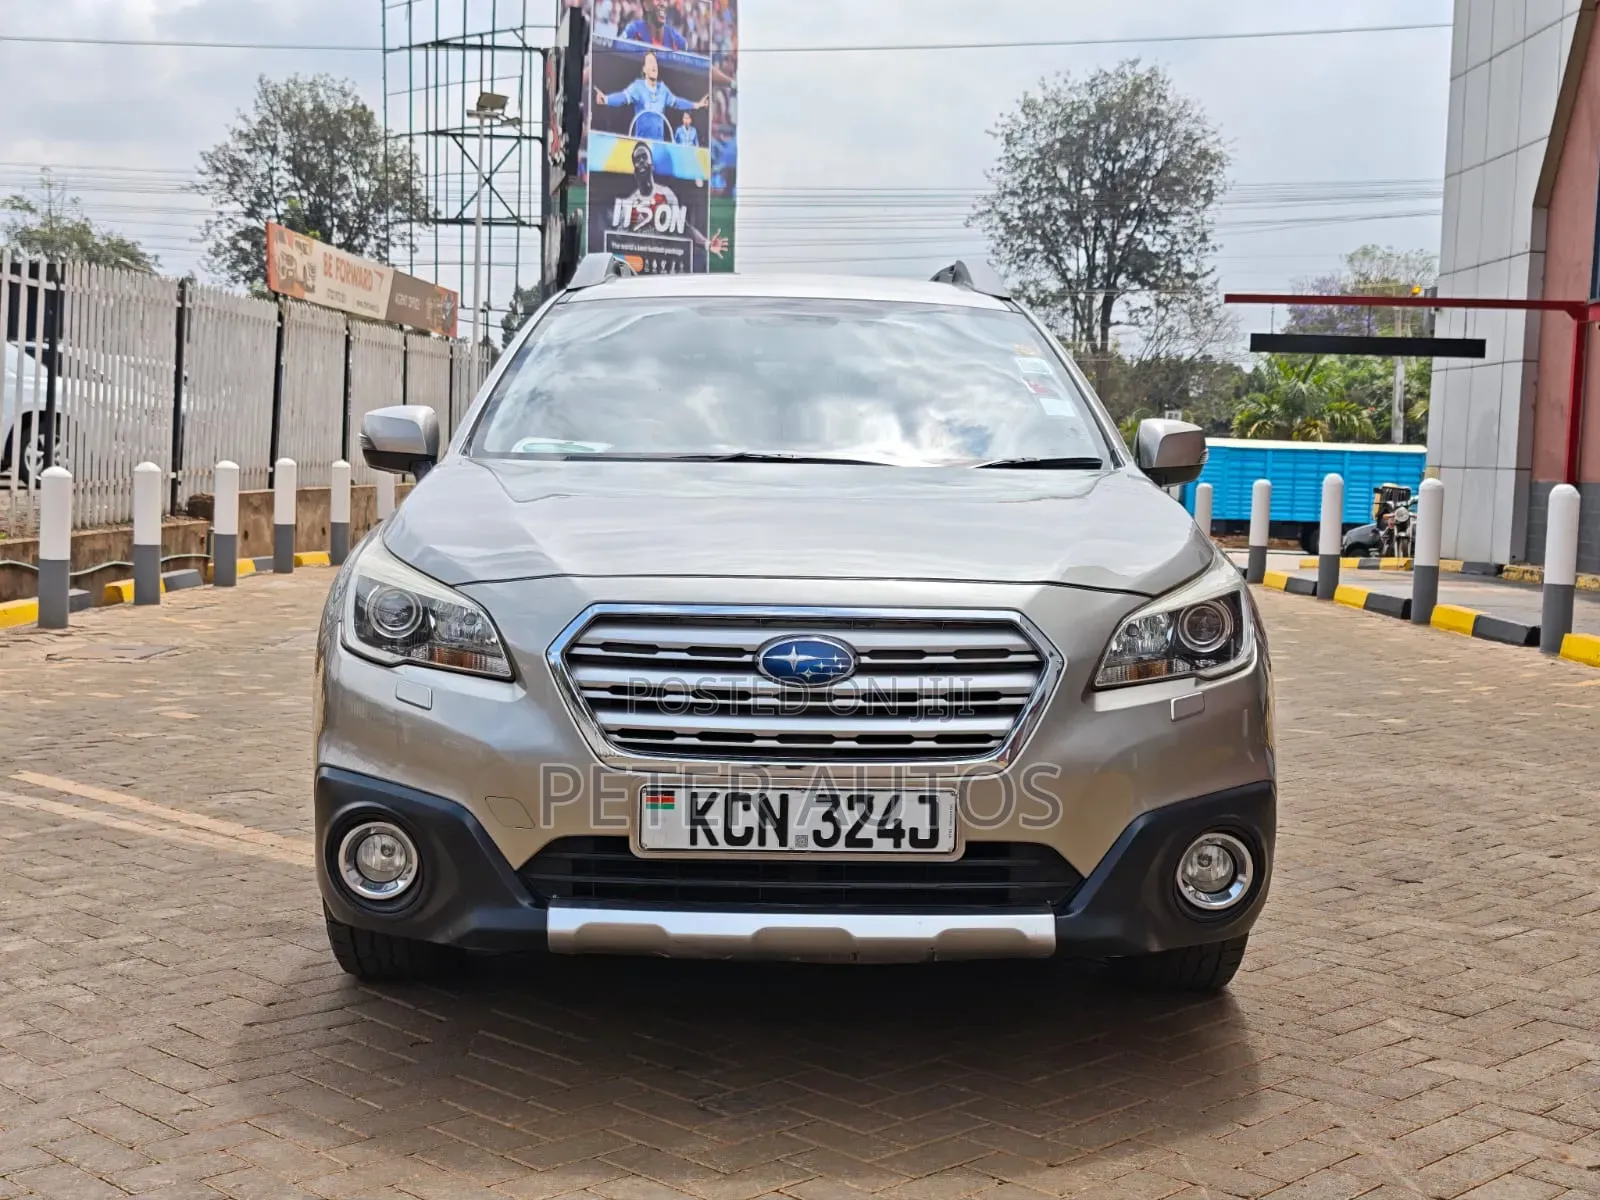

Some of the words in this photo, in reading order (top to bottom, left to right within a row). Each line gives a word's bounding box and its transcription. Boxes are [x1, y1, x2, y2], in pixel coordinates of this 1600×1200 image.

[654, 204, 688, 234] ON
[323, 252, 333, 278] BE
[335, 256, 373, 292] FORWARD
[689, 791, 789, 847] KCN
[812, 794, 940, 849] 324J
